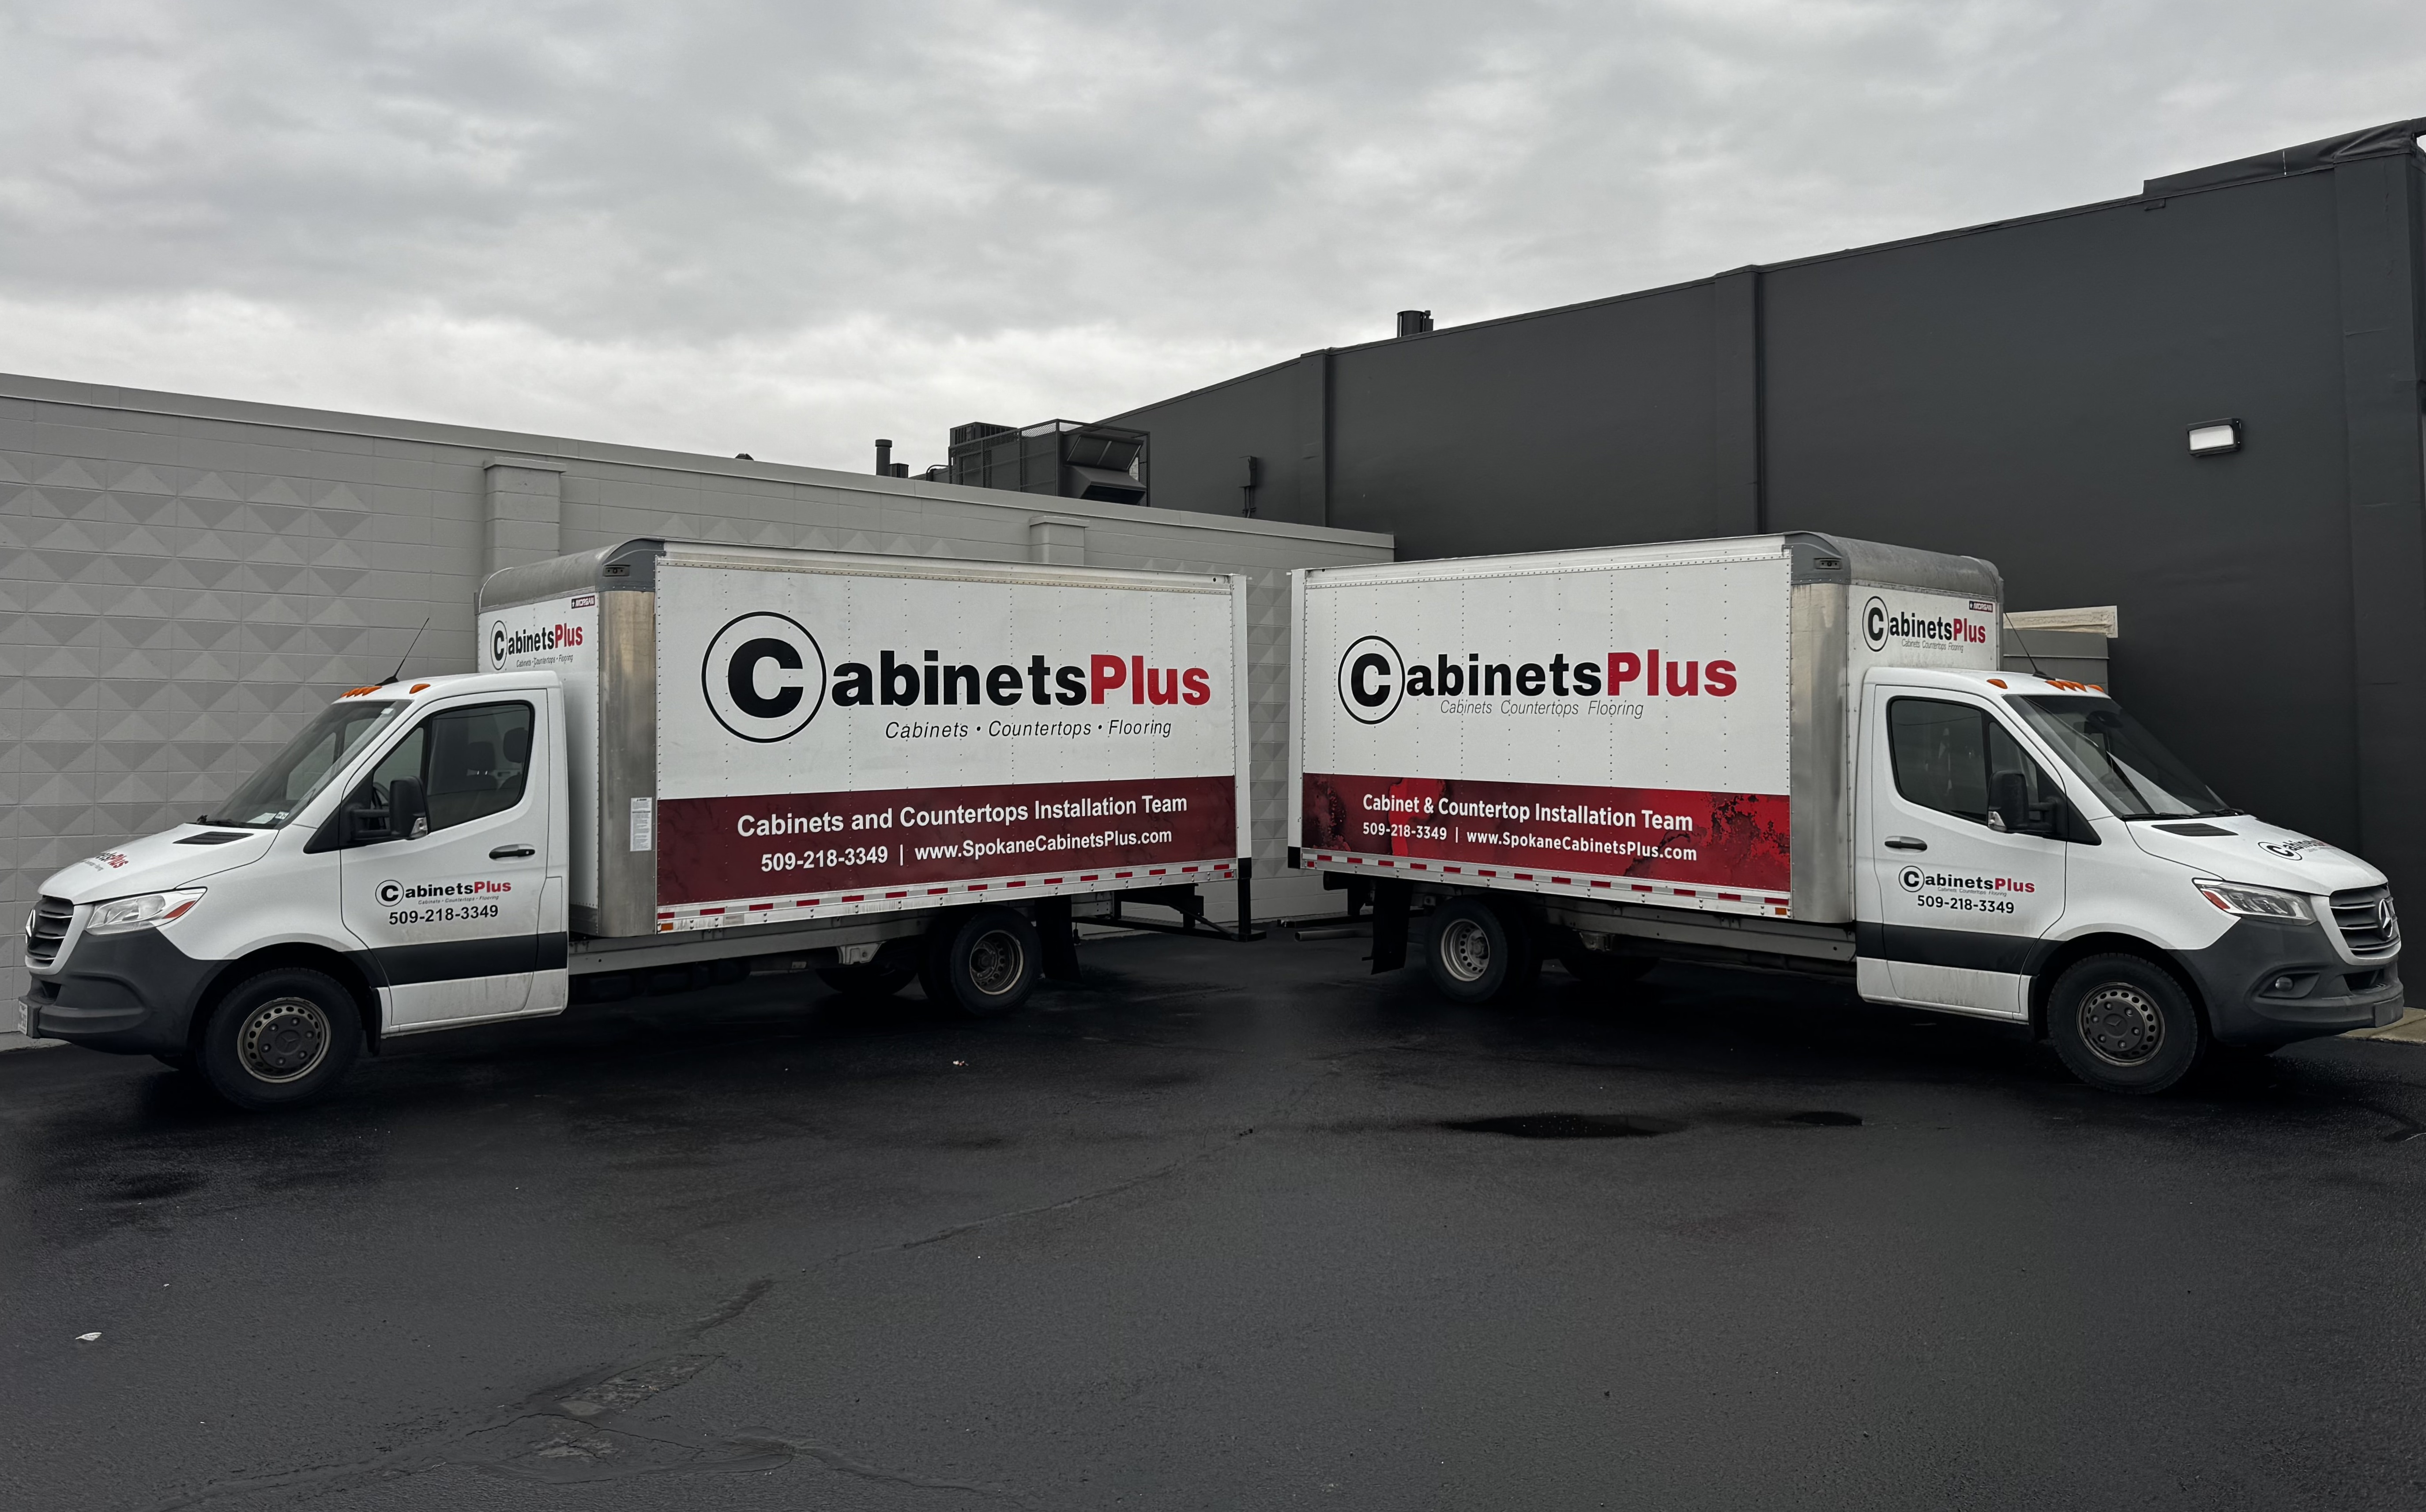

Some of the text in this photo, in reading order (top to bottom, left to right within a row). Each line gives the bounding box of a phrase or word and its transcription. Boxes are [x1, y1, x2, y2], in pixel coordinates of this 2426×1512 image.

[575, 597, 594, 607] MORGAN
[493, 623, 583, 661] CabinetsPlus
[1867, 607, 1986, 643] CabinetsPlus
[727, 637, 1211, 718] CabinetsPlus
[1350, 649, 1738, 708] CabinetsPlus
[1440, 699, 1644, 719] Cabinets Countertops Flooring
[885, 719, 1172, 739] Cabinets Countertops Flooring
[737, 795, 1187, 837] Cabinets and Countertops Installation Team
[1363, 794, 1693, 832] Cabinet & Countertop Installation Team
[761, 830, 1172, 872] 509-218-3349 www.SpokaneCabinetsPlus.com
[1362, 822, 1697, 861] 509-218-3349 www.SpokaneCabinetsPlus.com
[381, 881, 512, 902] CabinetsPlus
[1903, 870, 2035, 893] CabinetsPlus
[389, 904, 498, 925] 509-218-3349
[1918, 895, 2014, 914] 509-218-3349
